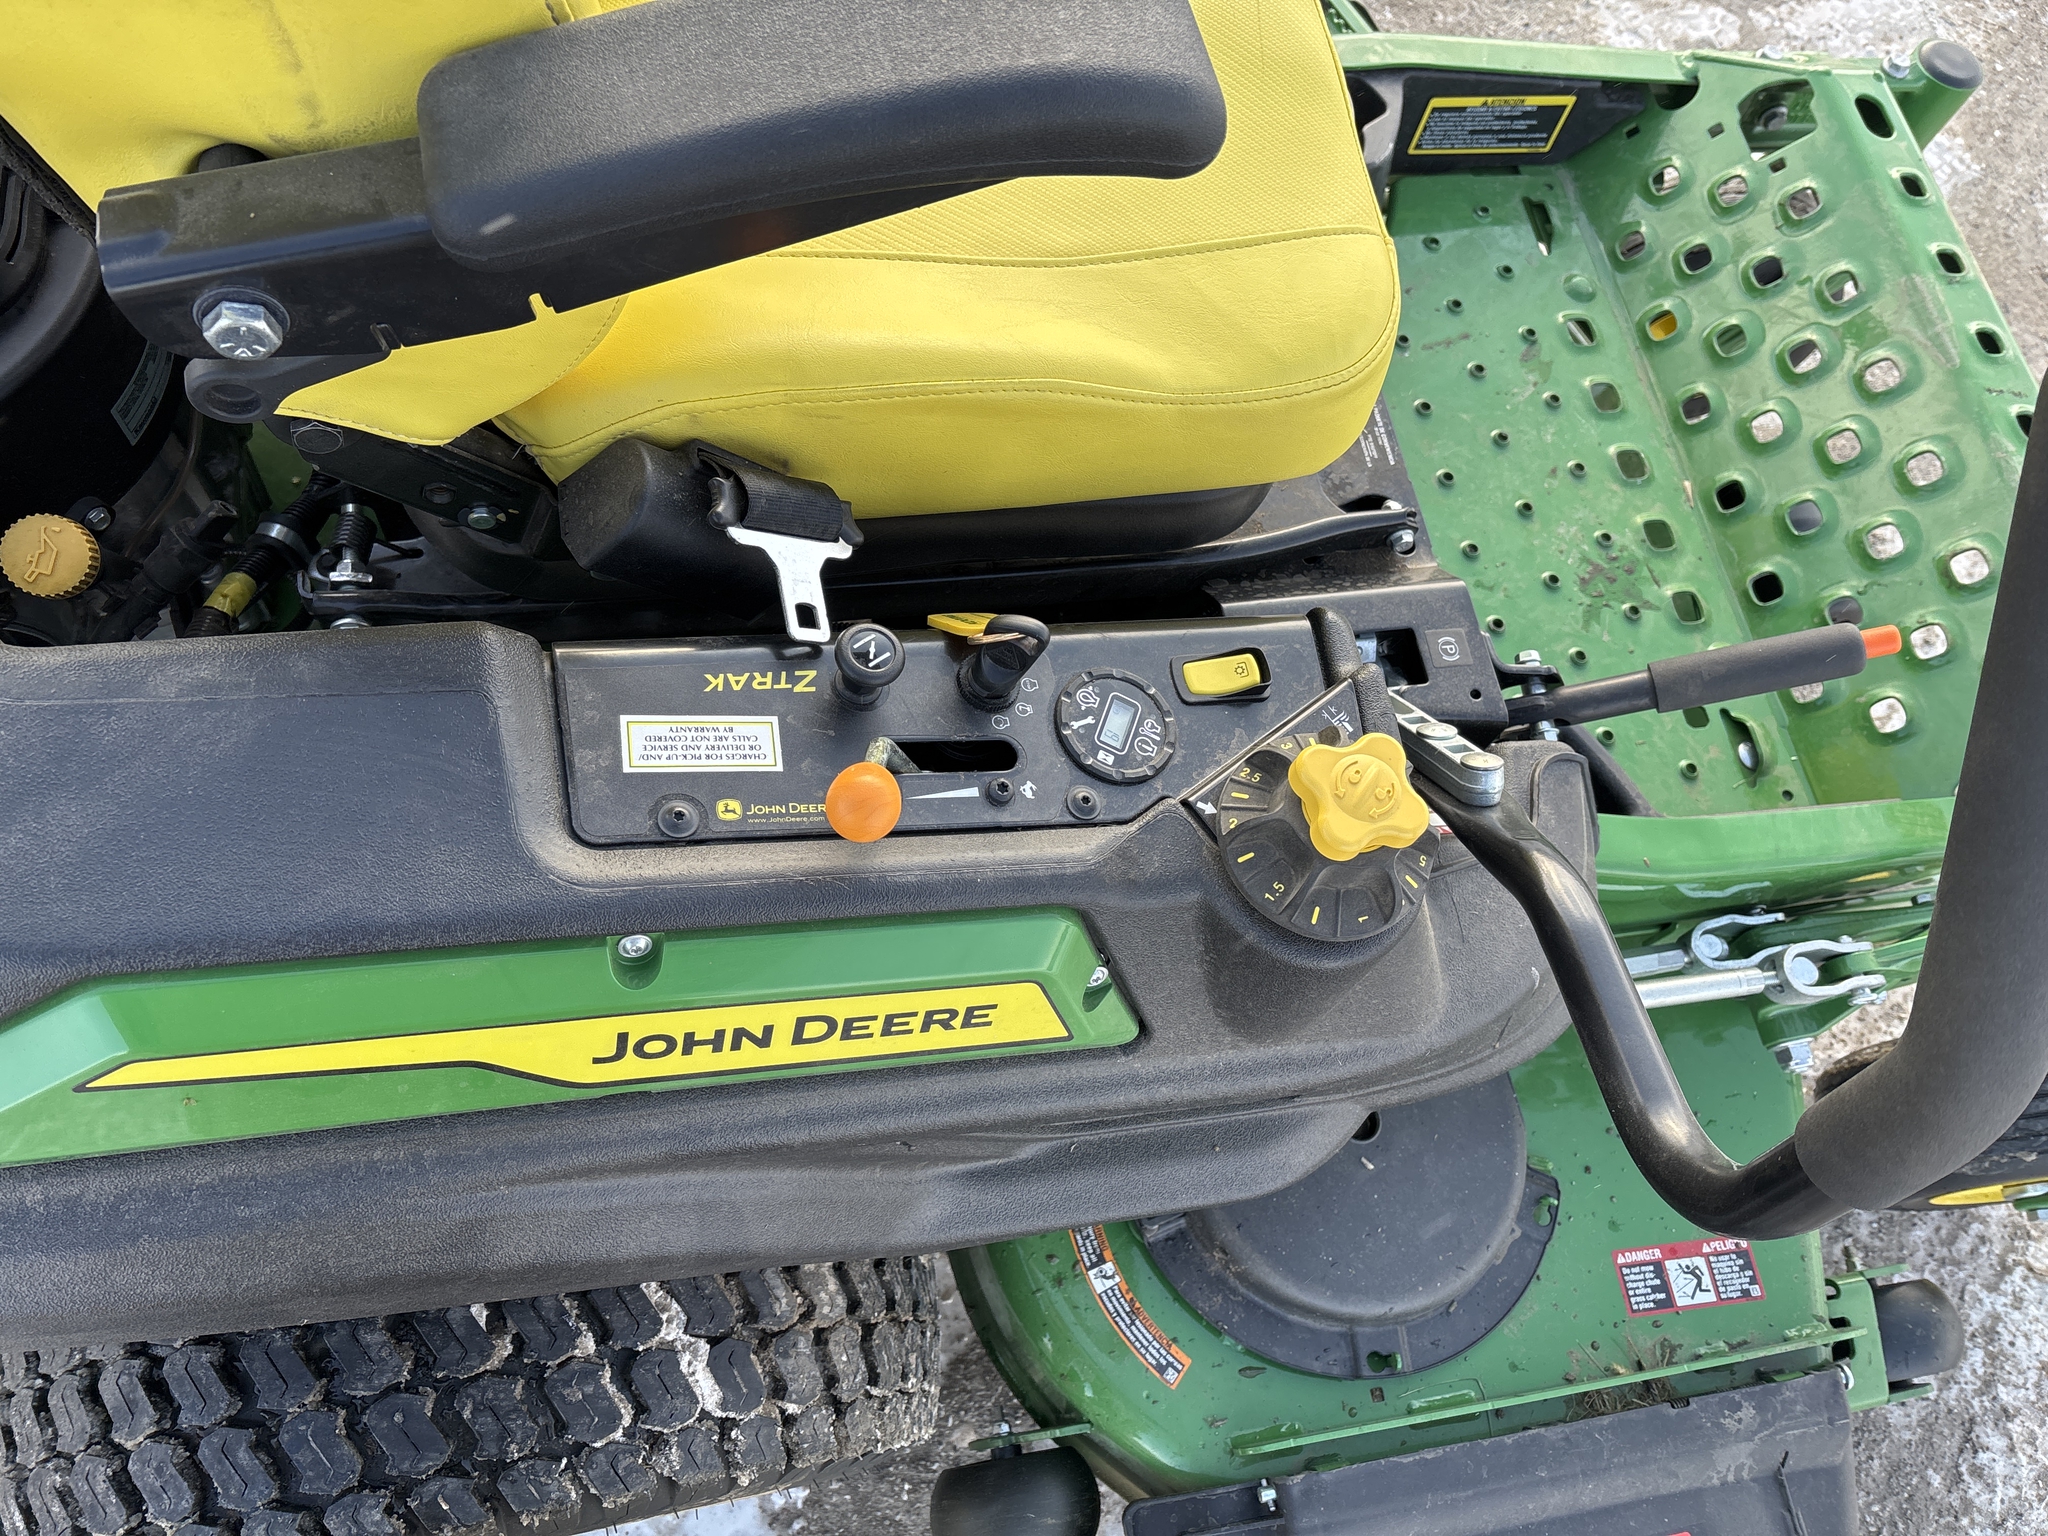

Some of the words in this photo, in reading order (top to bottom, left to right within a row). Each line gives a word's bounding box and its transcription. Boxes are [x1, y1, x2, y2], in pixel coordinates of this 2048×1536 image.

[703, 669, 818, 693] ZTRAK
[1240, 767, 1262, 783] 2.5
[746, 803, 786, 815] JOHN
[788, 802, 827, 813] DEER
[1228, 818, 1238, 829] 2
[1264, 881, 1285, 902] 1.5
[591, 1024, 775, 1065] JOHN
[790, 1003, 999, 1046] DEERE
[1710, 1240, 1747, 1251] PELIGO
[1625, 1249, 1661, 1262] DANGER
